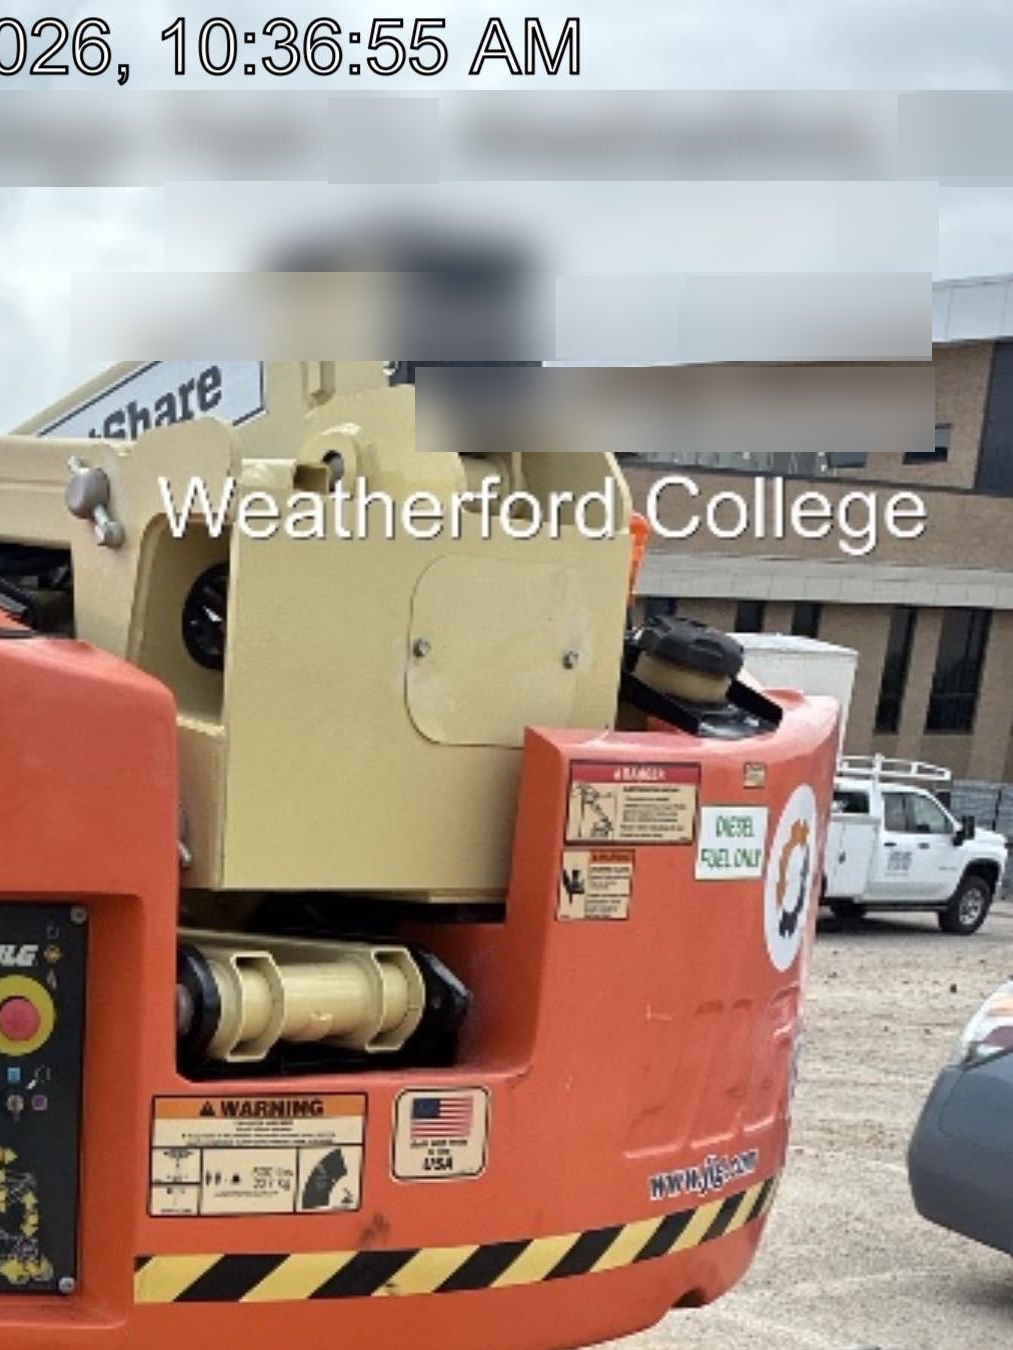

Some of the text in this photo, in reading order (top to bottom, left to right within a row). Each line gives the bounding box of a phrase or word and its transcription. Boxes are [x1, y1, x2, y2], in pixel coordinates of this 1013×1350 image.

[716, 815, 756, 838] DIESEL
[701, 848, 731, 868] FUEL
[220, 1099, 325, 1118] WARNING
[423, 1156, 453, 1171] USA
